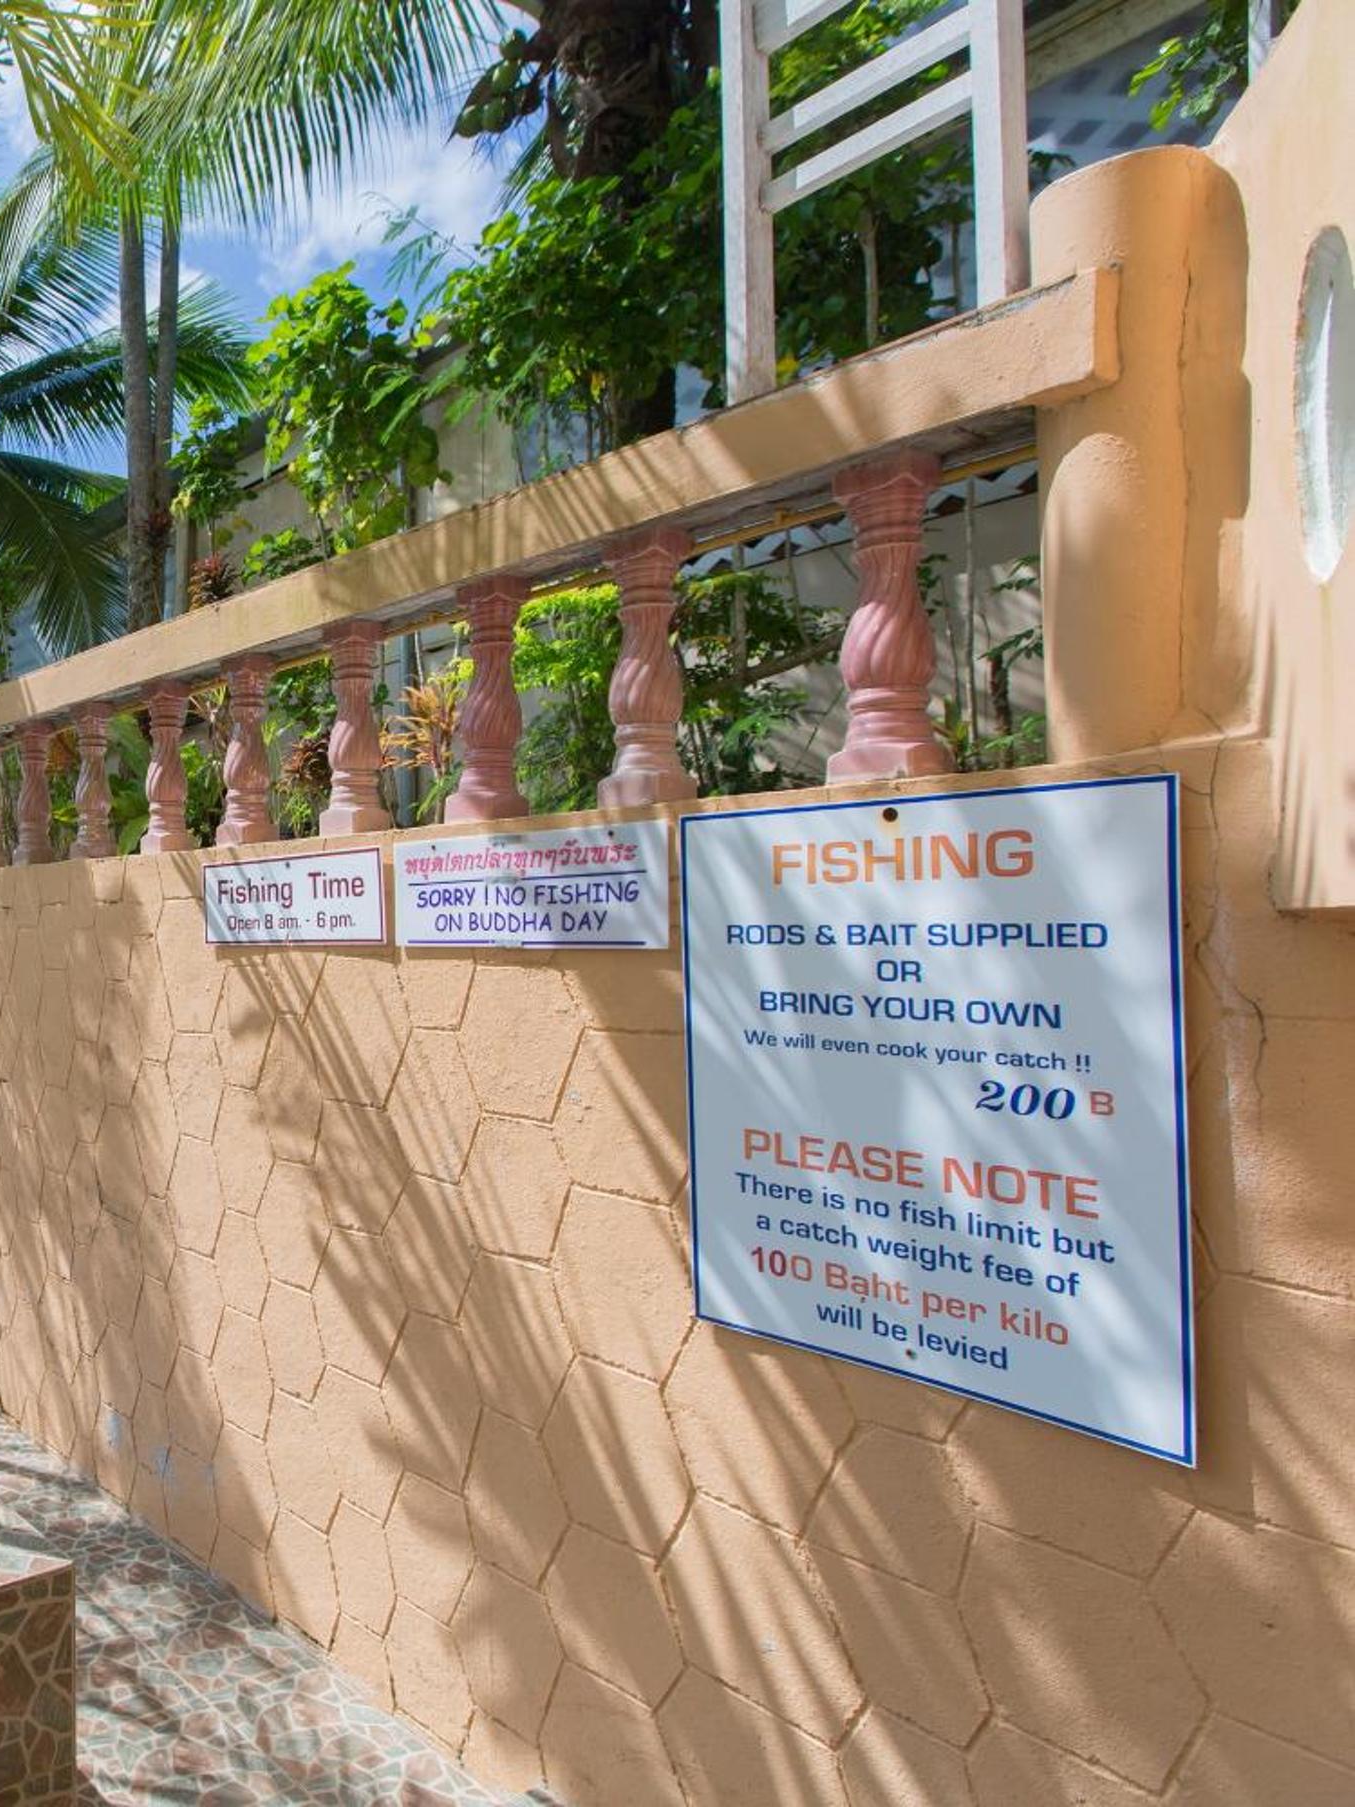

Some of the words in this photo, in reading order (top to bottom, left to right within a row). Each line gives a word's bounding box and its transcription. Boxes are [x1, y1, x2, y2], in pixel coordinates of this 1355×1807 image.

[772, 829, 1034, 885] FISHING
[217, 877, 293, 909] Fishing
[308, 872, 365, 899] Time
[416, 888, 476, 908] SORRY
[495, 886, 526, 906] NO
[534, 880, 639, 906] FISHING
[227, 915, 261, 933] Open
[264, 914, 274, 930] 8
[278, 917, 303, 929] am.
[317, 912, 326, 928] 6
[330, 913, 356, 931] pm.
[435, 913, 463, 932] ON
[469, 911, 553, 932] BUDDHA
[561, 910, 608, 931] DAY
[727, 924, 805, 945] RODS
[815, 924, 836, 945] &
[847, 924, 918, 946] BAIT
[927, 923, 1108, 949] SUPPLIED
[876, 959, 921, 982] OR
[759, 992, 853, 1016] BRING
[862, 996, 955, 1022] YOUR
[966, 1001, 1062, 1029] OWN
[744, 1029, 778, 1047] We
[783, 1033, 815, 1049] will
[821, 1039, 869, 1054] even
[876, 1040, 928, 1060] cook
[935, 1046, 987, 1065] your
[995, 1051, 1066, 1071] catch
[1075, 1053, 1092, 1073] !!
[975, 1080, 1076, 1120] 200
[1089, 1091, 1115, 1116] B
[743, 1128, 924, 1189] PLEASE
[944, 1157, 1099, 1219] NOTE
[735, 1172, 813, 1204] There
[822, 1186, 845, 1210] is
[855, 1196, 890, 1218] no
[900, 1200, 956, 1231] fish
[967, 1211, 1042, 1248] limit
[1053, 1227, 1115, 1263] but
[756, 1213, 771, 1231] a
[779, 1217, 858, 1249] catch
[867, 1235, 973, 1274] weight
[983, 1257, 1033, 1287] fee
[1045, 1271, 1080, 1297] of
[750, 1246, 813, 1282] 100
[824, 1262, 910, 1305] Baht
[922, 1289, 986, 1323] per
[999, 1302, 1069, 1345] kilo
[816, 1303, 863, 1330] will
[872, 1312, 908, 1342] be
[918, 1324, 1009, 1371] levied
